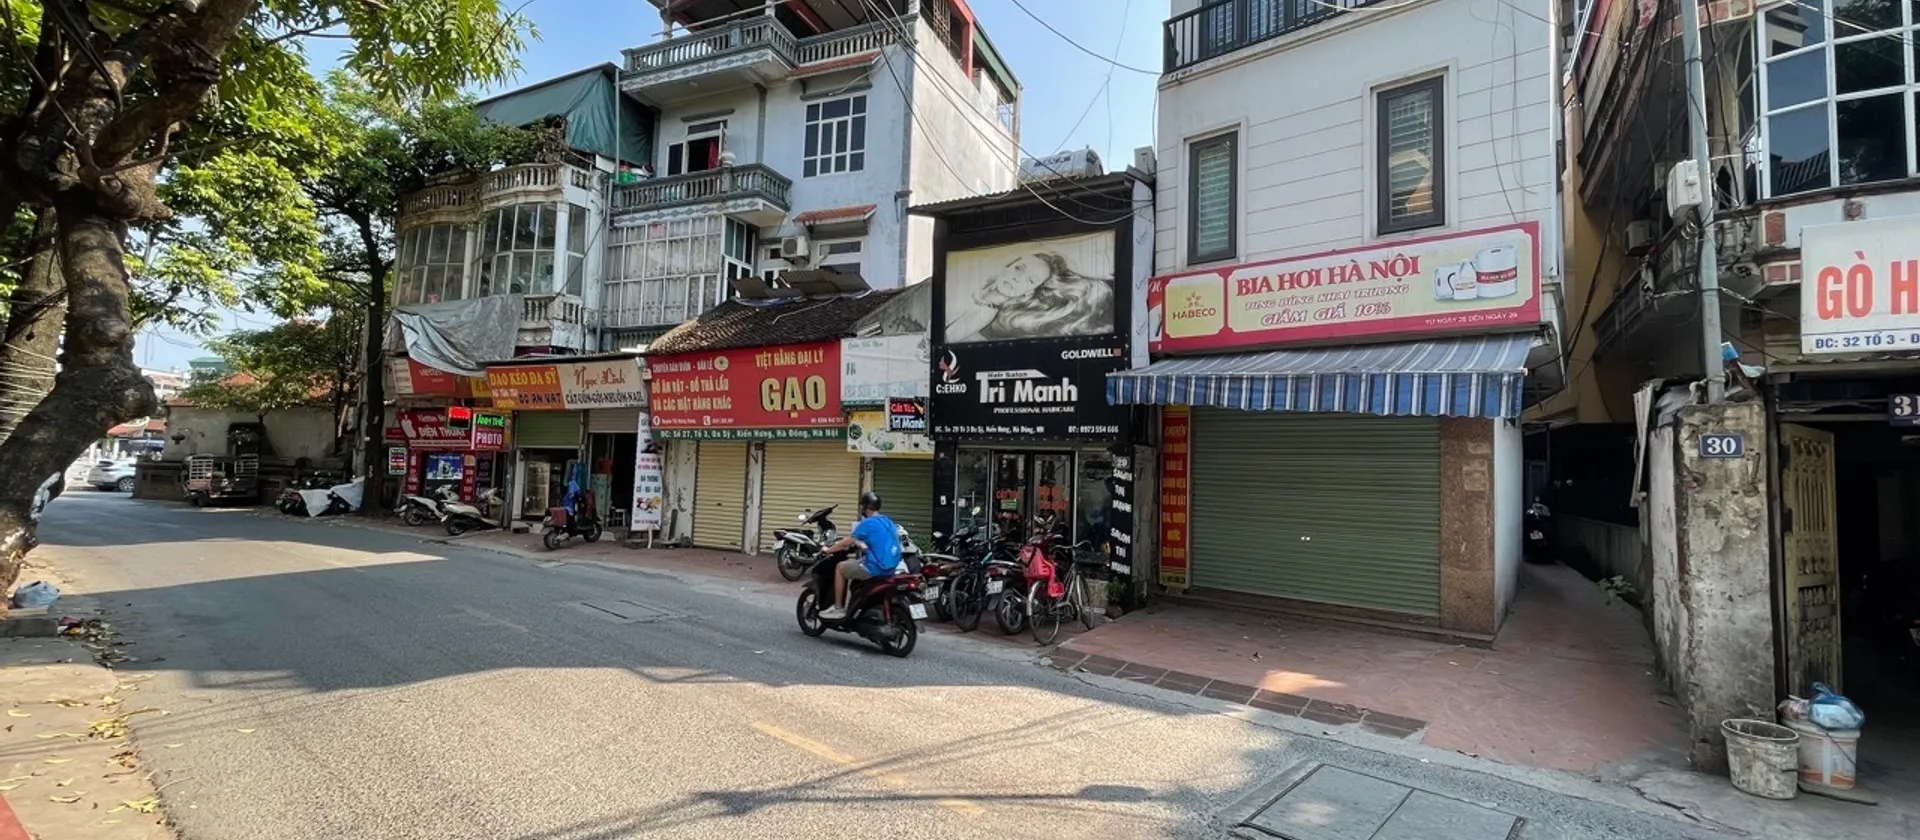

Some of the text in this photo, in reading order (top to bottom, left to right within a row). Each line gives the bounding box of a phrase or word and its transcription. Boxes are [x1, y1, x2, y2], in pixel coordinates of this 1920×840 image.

[1236, 253, 1421, 296] BIA HƠI HÀ NỘI
[1817, 251, 1873, 321] GÒ
[1317, 291, 1350, 303] KHAI
[1172, 307, 1217, 320] HABECO
[1261, 302, 1391, 327] GIẢM GIÁ 10%
[1815, 338, 1838, 349] ĐC:
[1843, 337, 1860, 347] 32
[1864, 331, 1881, 346] TỔ
[1886, 335, 1895, 345] 3
[755, 351, 772, 370] VIỆT
[797, 350, 812, 367] ĐẠI
[814, 347, 824, 364] LÝ
[1061, 349, 1113, 359] GOLDWELL
[489, 372, 508, 386] DAO
[530, 372, 543, 385] ĐA
[936, 384, 967, 394] C:EHKO
[663, 396, 676, 411] CÁC
[761, 375, 826, 418] GẠO
[993, 406, 1041, 414] PROFESSIONAL
[476, 432, 502, 445] PHOTO
[1707, 437, 1737, 454] 30
[1118, 458, 1128, 468] 29
[1113, 468, 1132, 481] SALON
[1110, 527, 1131, 544] SALON
